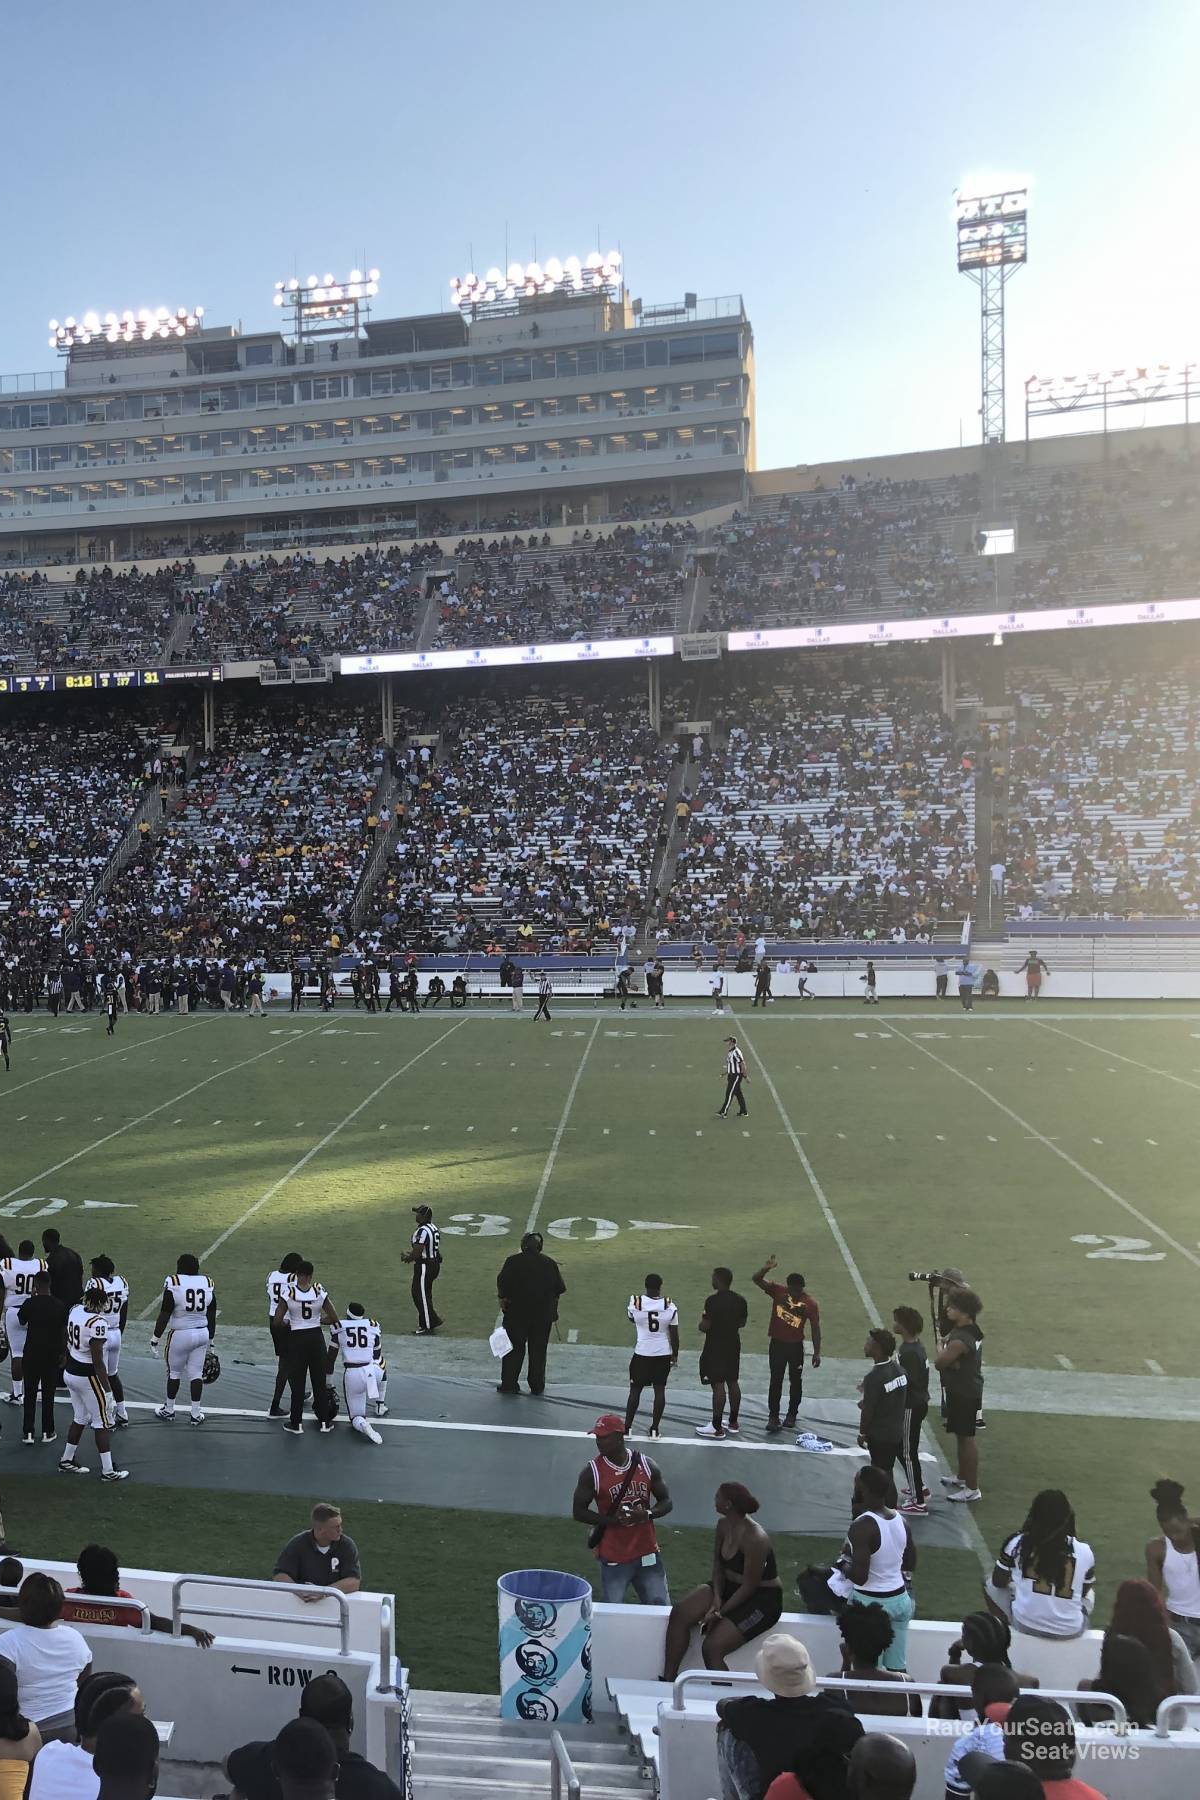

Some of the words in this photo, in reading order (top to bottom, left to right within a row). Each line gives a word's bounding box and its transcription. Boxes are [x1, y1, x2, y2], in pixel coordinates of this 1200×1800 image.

[65, 675, 92, 687] 8:12
[144, 672, 159, 683] 31
[20, 682, 27, 690] 3
[39, 681, 45, 690] 7
[440, 1213, 619, 1241] 30
[185, 1288, 206, 1312] 93
[301, 1302, 312, 1320] 6
[648, 1311, 659, 1332] 6
[96, 1326, 106, 1337] 99
[346, 1327, 368, 1348] 56
[331, 1557, 340, 1570] P
[268, 1665, 312, 1688] ROW
